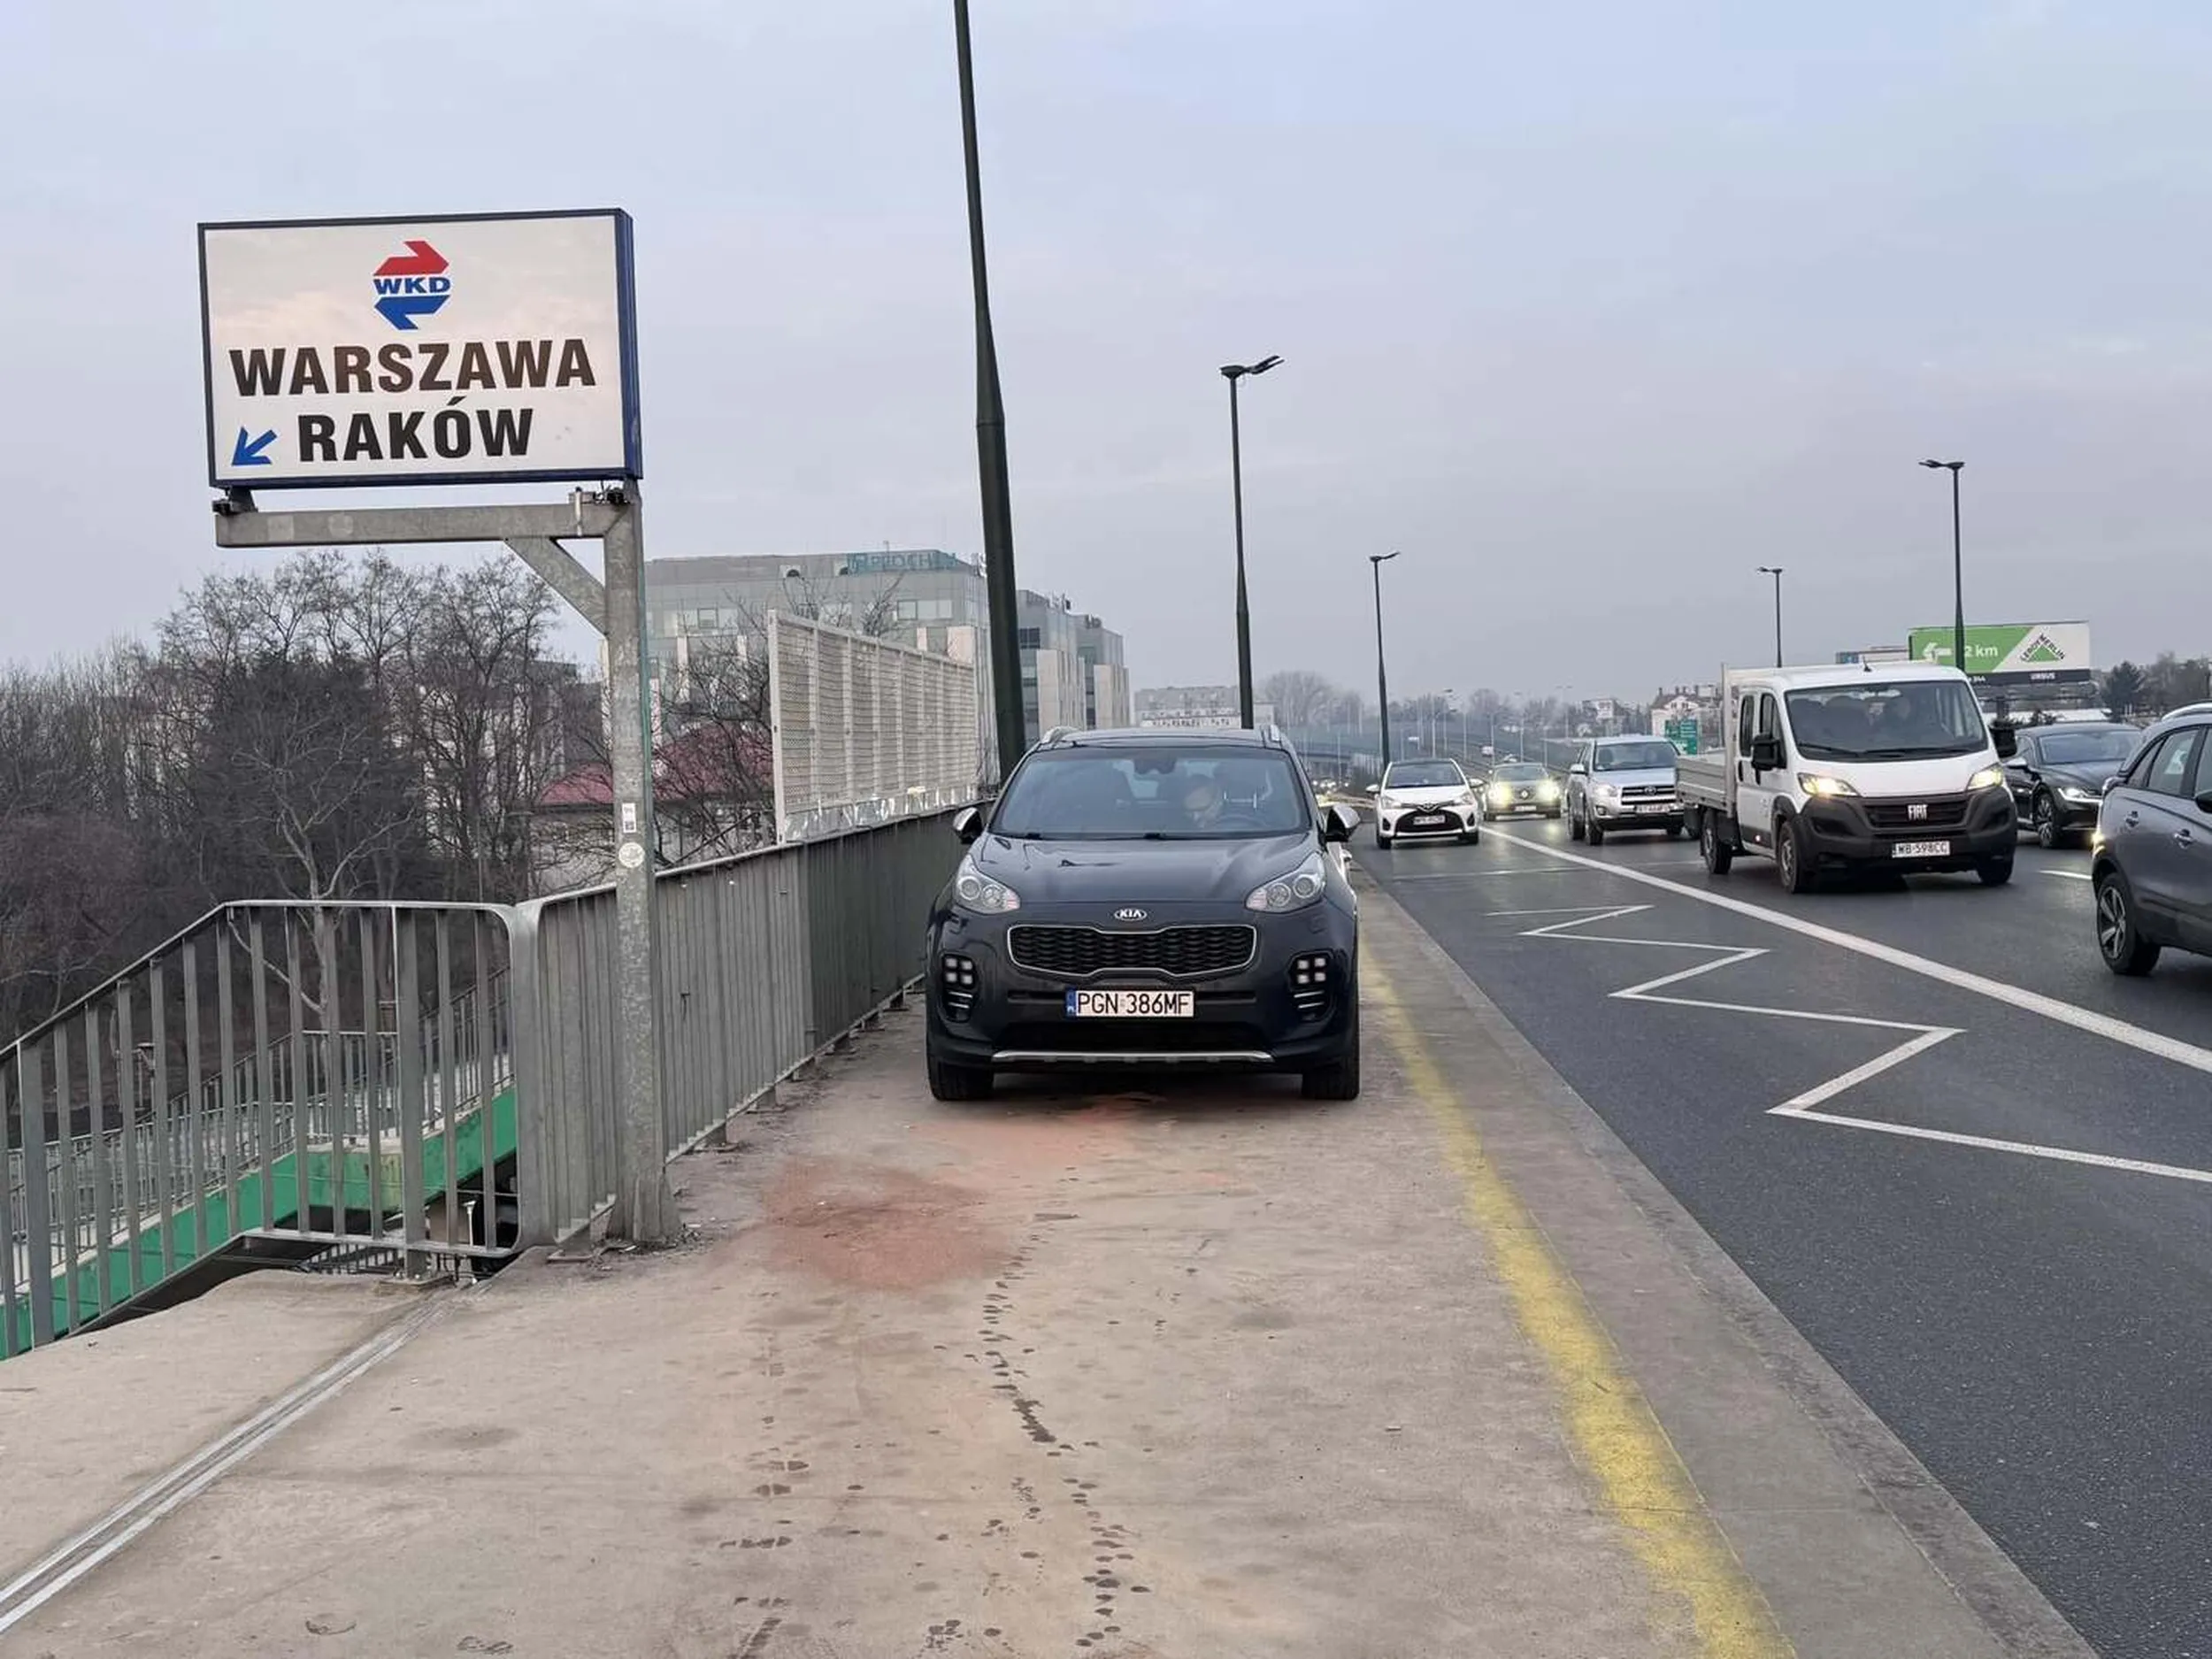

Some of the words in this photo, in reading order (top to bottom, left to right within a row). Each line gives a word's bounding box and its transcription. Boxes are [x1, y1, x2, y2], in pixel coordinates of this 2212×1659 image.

[373, 276, 451, 295] WKD
[228, 338, 596, 397] WARSZAWA
[297, 396, 534, 462] RAKÓW
[1976, 645, 1998, 657] km
[2019, 639, 2040, 662] LEROY
[2039, 633, 2065, 660] MERLIN
[1908, 803, 1928, 821] FIAT
[1119, 909, 1141, 918] KIA
[1078, 992, 1118, 1014] PGN
[1126, 992, 1191, 1014] 386MF
